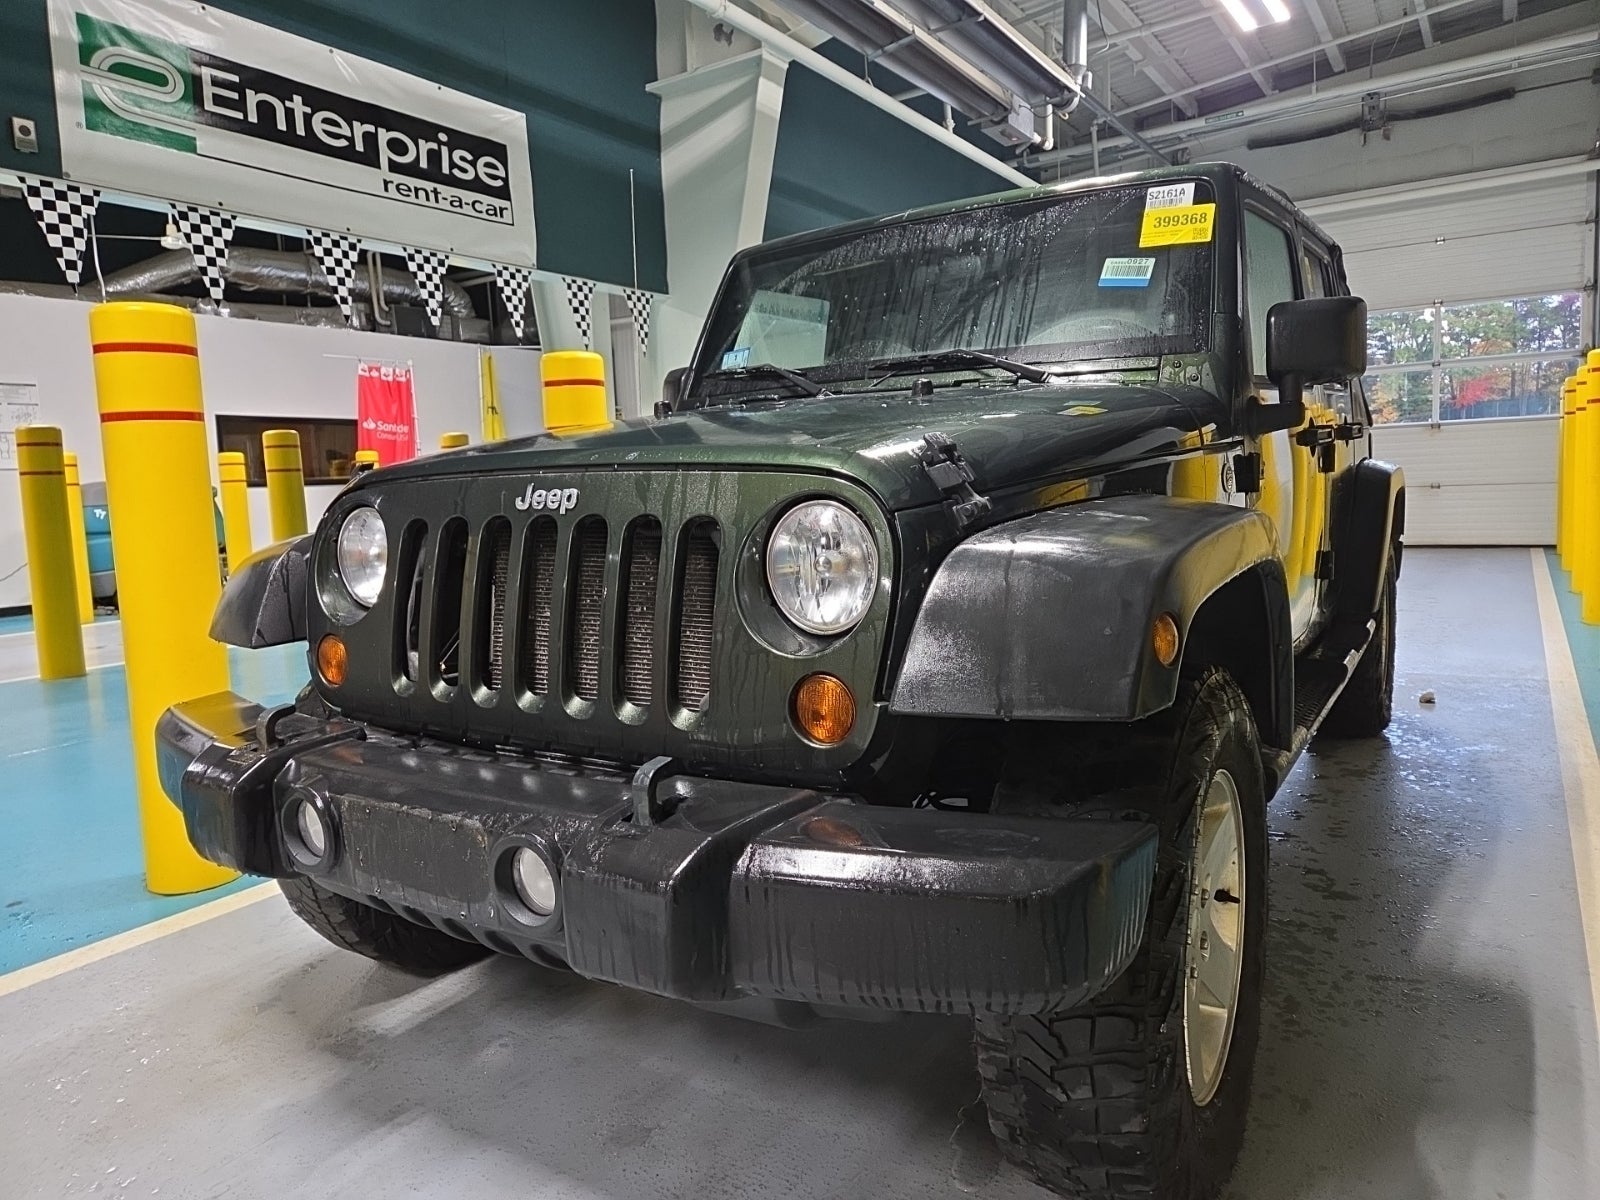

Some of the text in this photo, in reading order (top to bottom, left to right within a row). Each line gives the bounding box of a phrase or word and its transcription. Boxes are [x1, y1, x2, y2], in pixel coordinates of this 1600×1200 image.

[201, 65, 506, 187] Enterprise
[383, 178, 509, 219] rent-a-car
[1148, 187, 1186, 201] S2161A
[1153, 212, 1208, 229] 399368
[515, 482, 579, 514] Jeep
